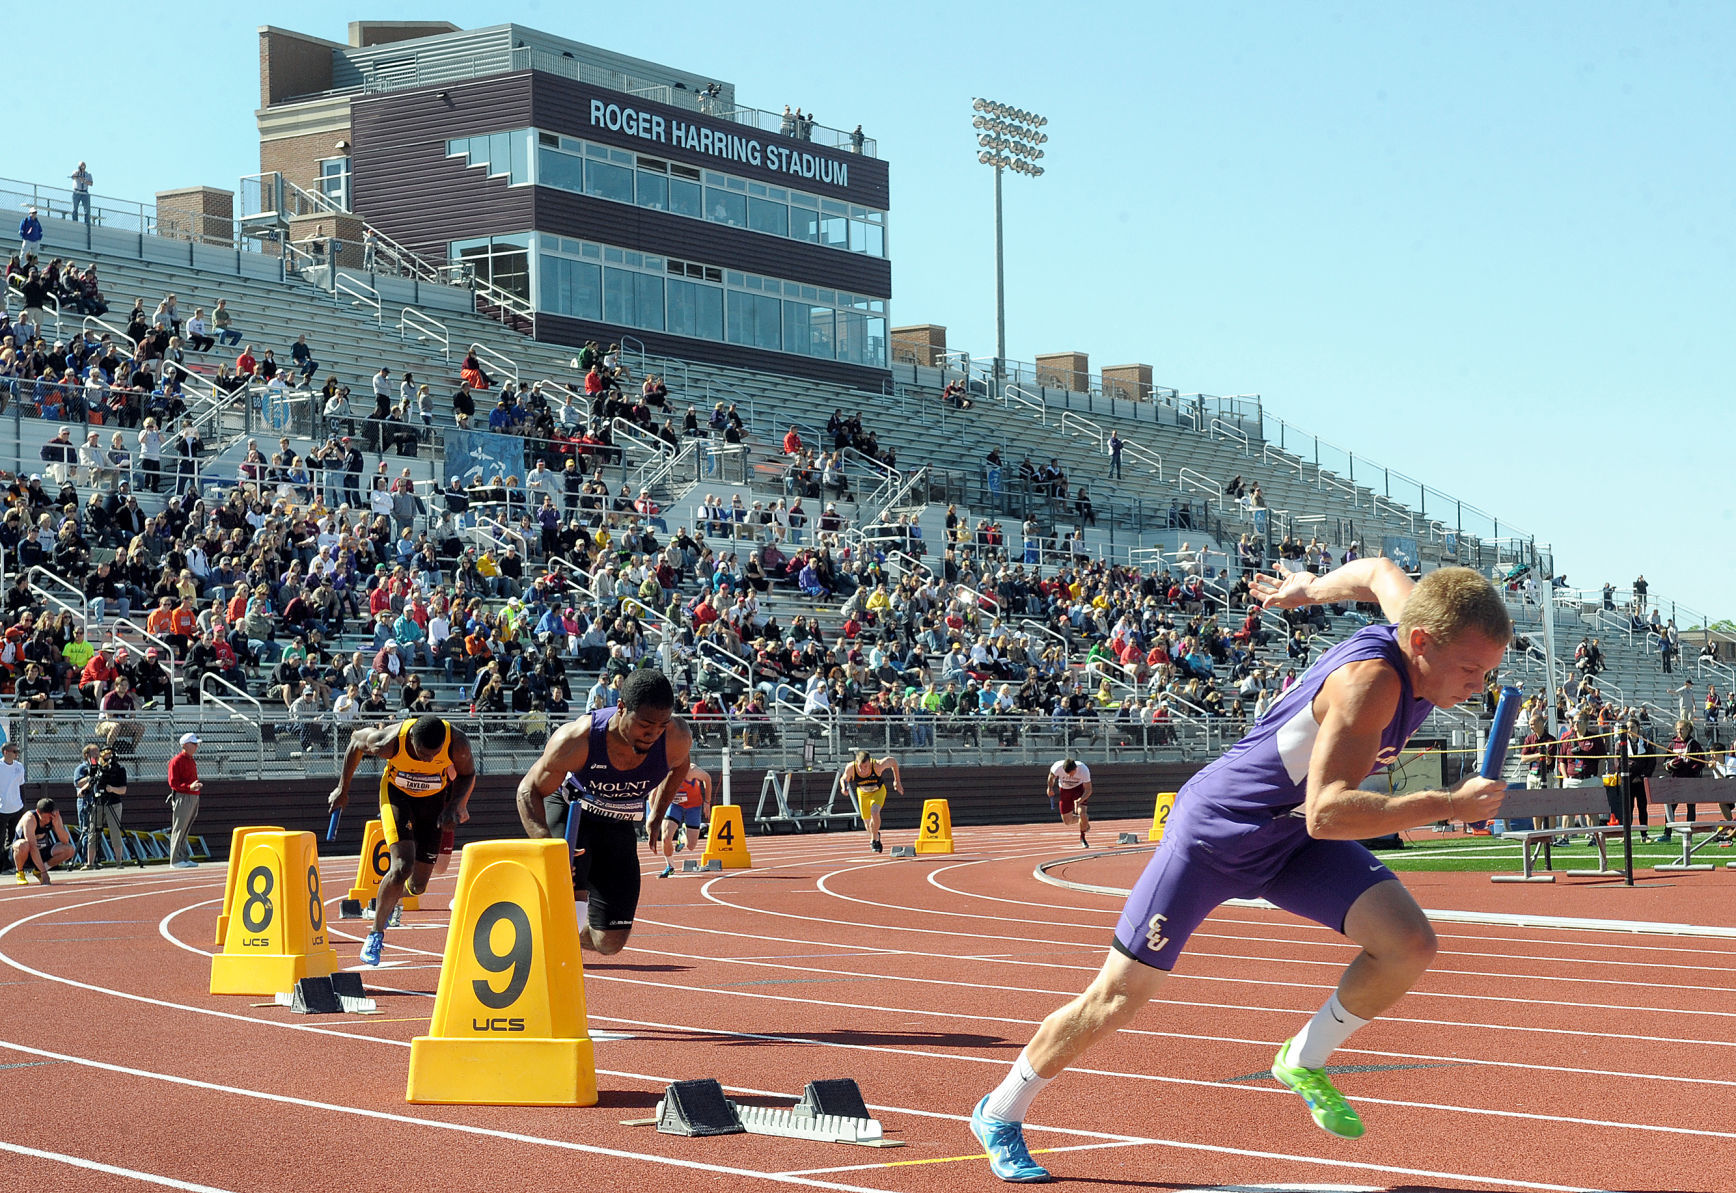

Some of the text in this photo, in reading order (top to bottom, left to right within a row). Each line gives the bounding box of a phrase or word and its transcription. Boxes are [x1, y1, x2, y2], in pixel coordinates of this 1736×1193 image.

[590, 99, 848, 187] ROGER HARRING STADIUM
[406, 780, 430, 790] TAYLOR
[589, 780, 650, 792] MOUNT
[926, 811, 940, 834] 3
[1159, 804, 1171, 825] 2
[717, 820, 735, 846] 4
[372, 839, 392, 877] 6
[242, 865, 275, 934] 8
[307, 864, 323, 932] 8
[242, 937, 270, 947] UCS
[311, 935, 324, 946] UCS
[472, 900, 533, 1010] 9
[472, 1017, 526, 1032] UCS
